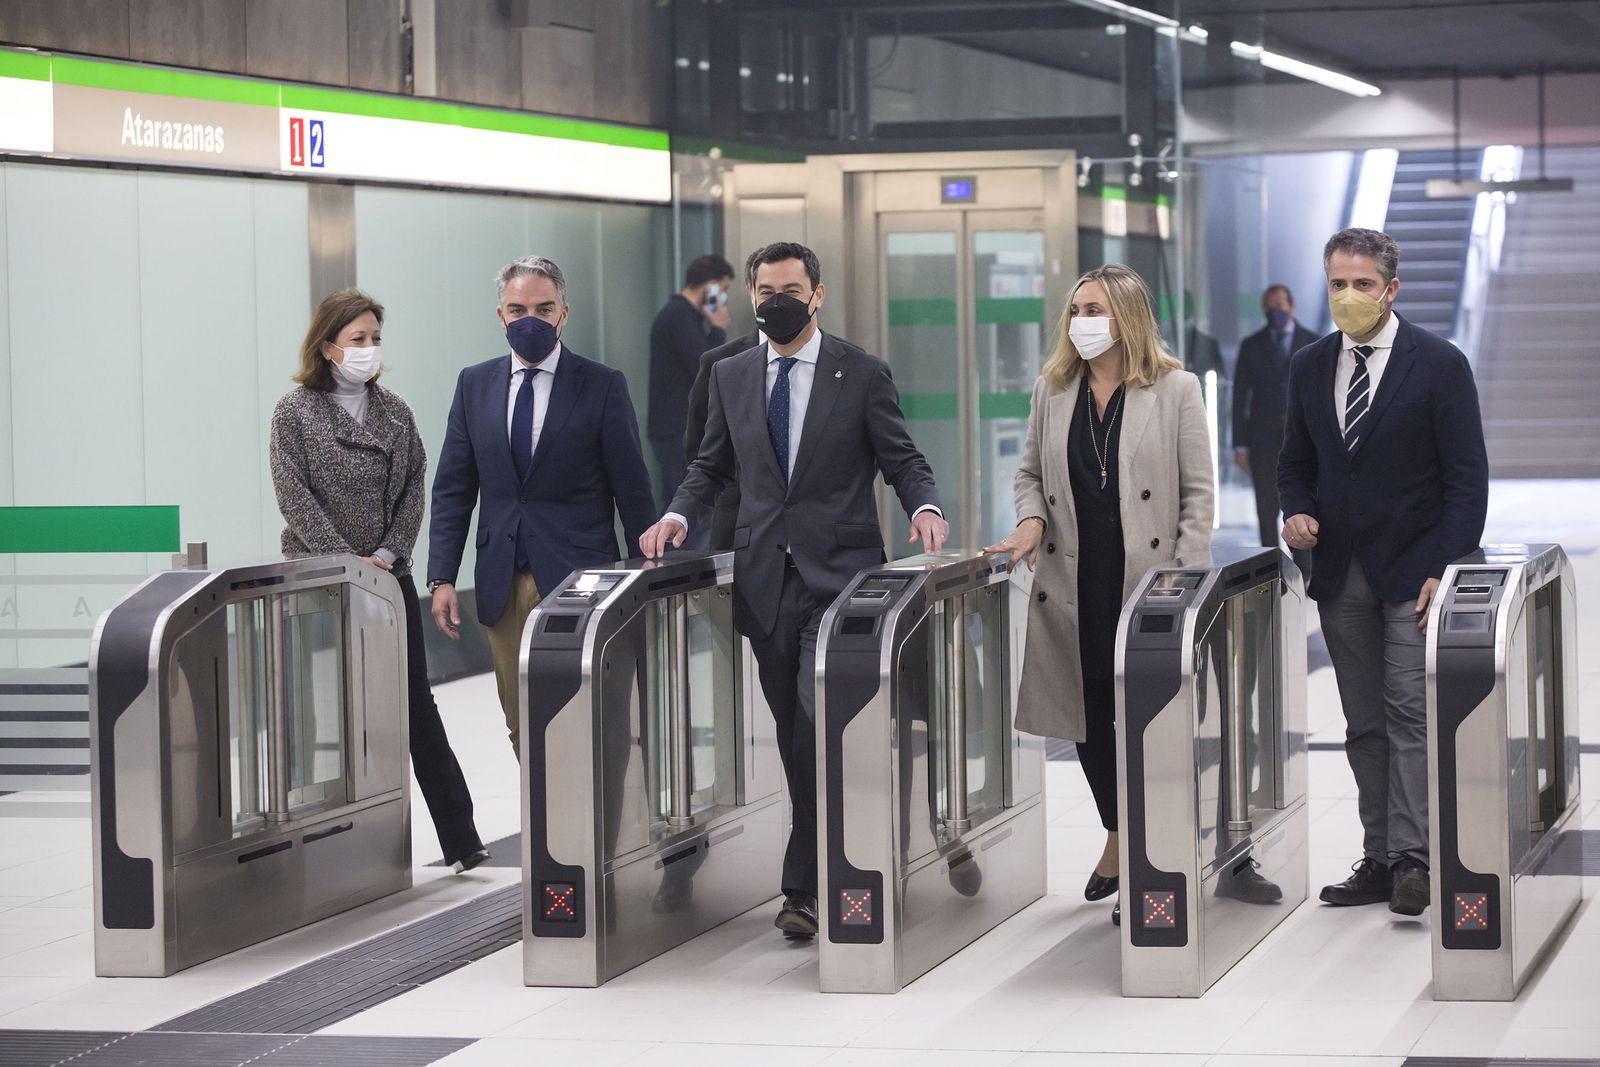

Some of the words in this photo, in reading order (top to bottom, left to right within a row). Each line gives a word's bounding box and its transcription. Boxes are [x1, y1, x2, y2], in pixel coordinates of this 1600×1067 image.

[121, 107, 225, 154] Atarazanas
[291, 121, 303, 163] 1
[310, 122, 323, 165] 2
